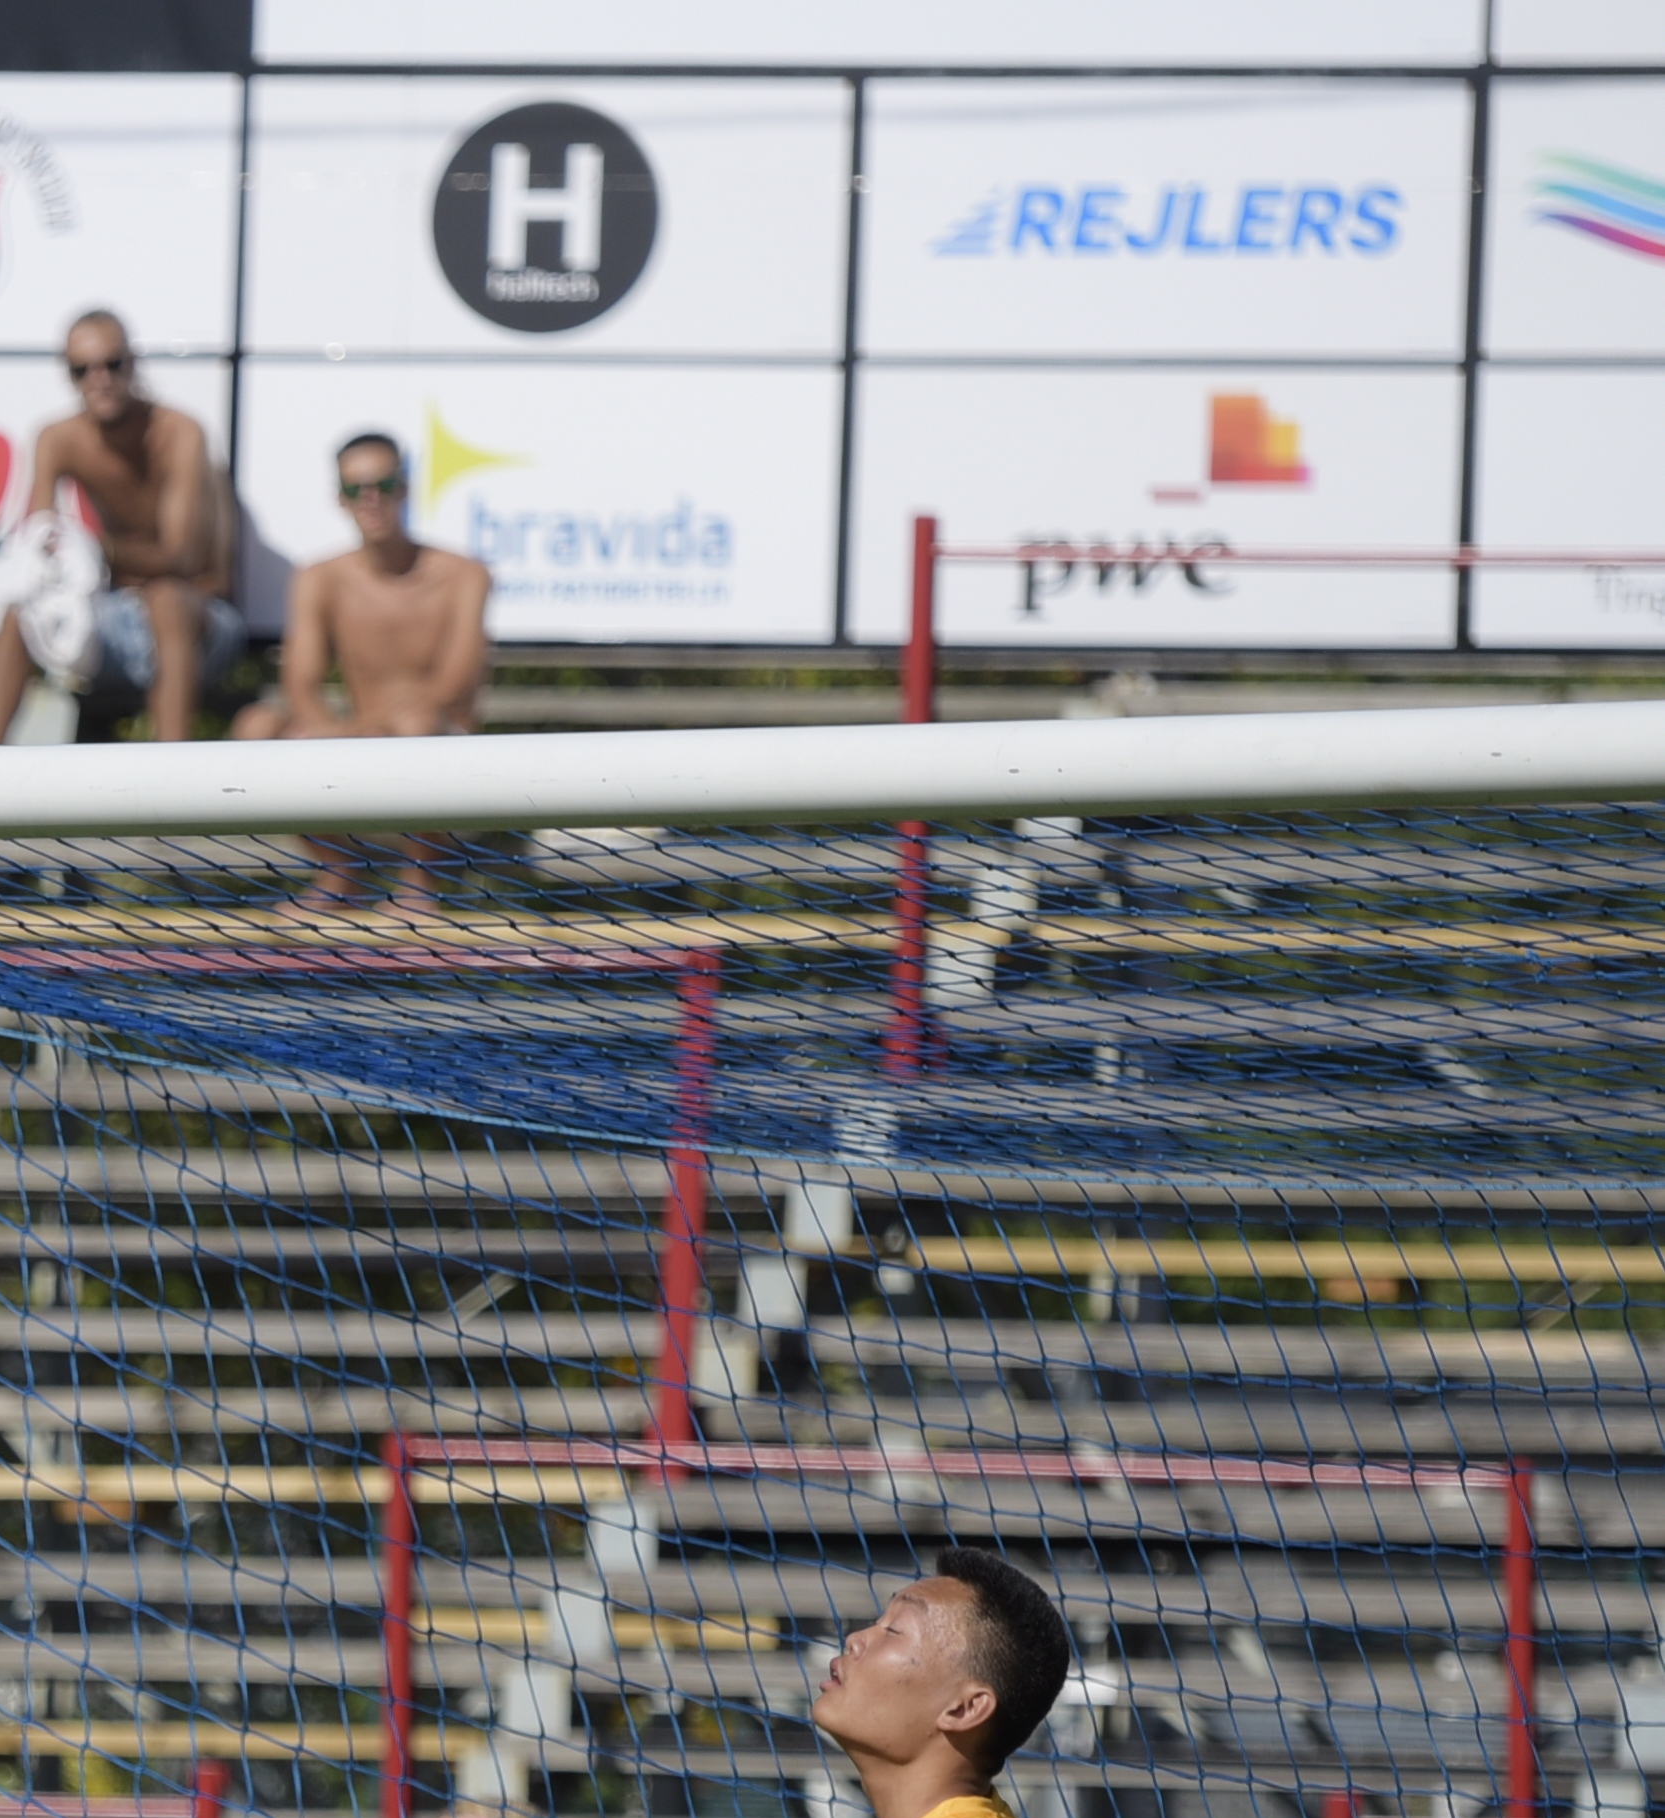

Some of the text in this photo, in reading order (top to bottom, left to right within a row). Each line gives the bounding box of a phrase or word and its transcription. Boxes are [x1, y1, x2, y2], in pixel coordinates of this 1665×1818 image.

[487, 142, 604, 270] H
[1008, 184, 1405, 255] REJLERS
[467, 493, 734, 568] bravida
[1013, 533, 1234, 619] pwc
